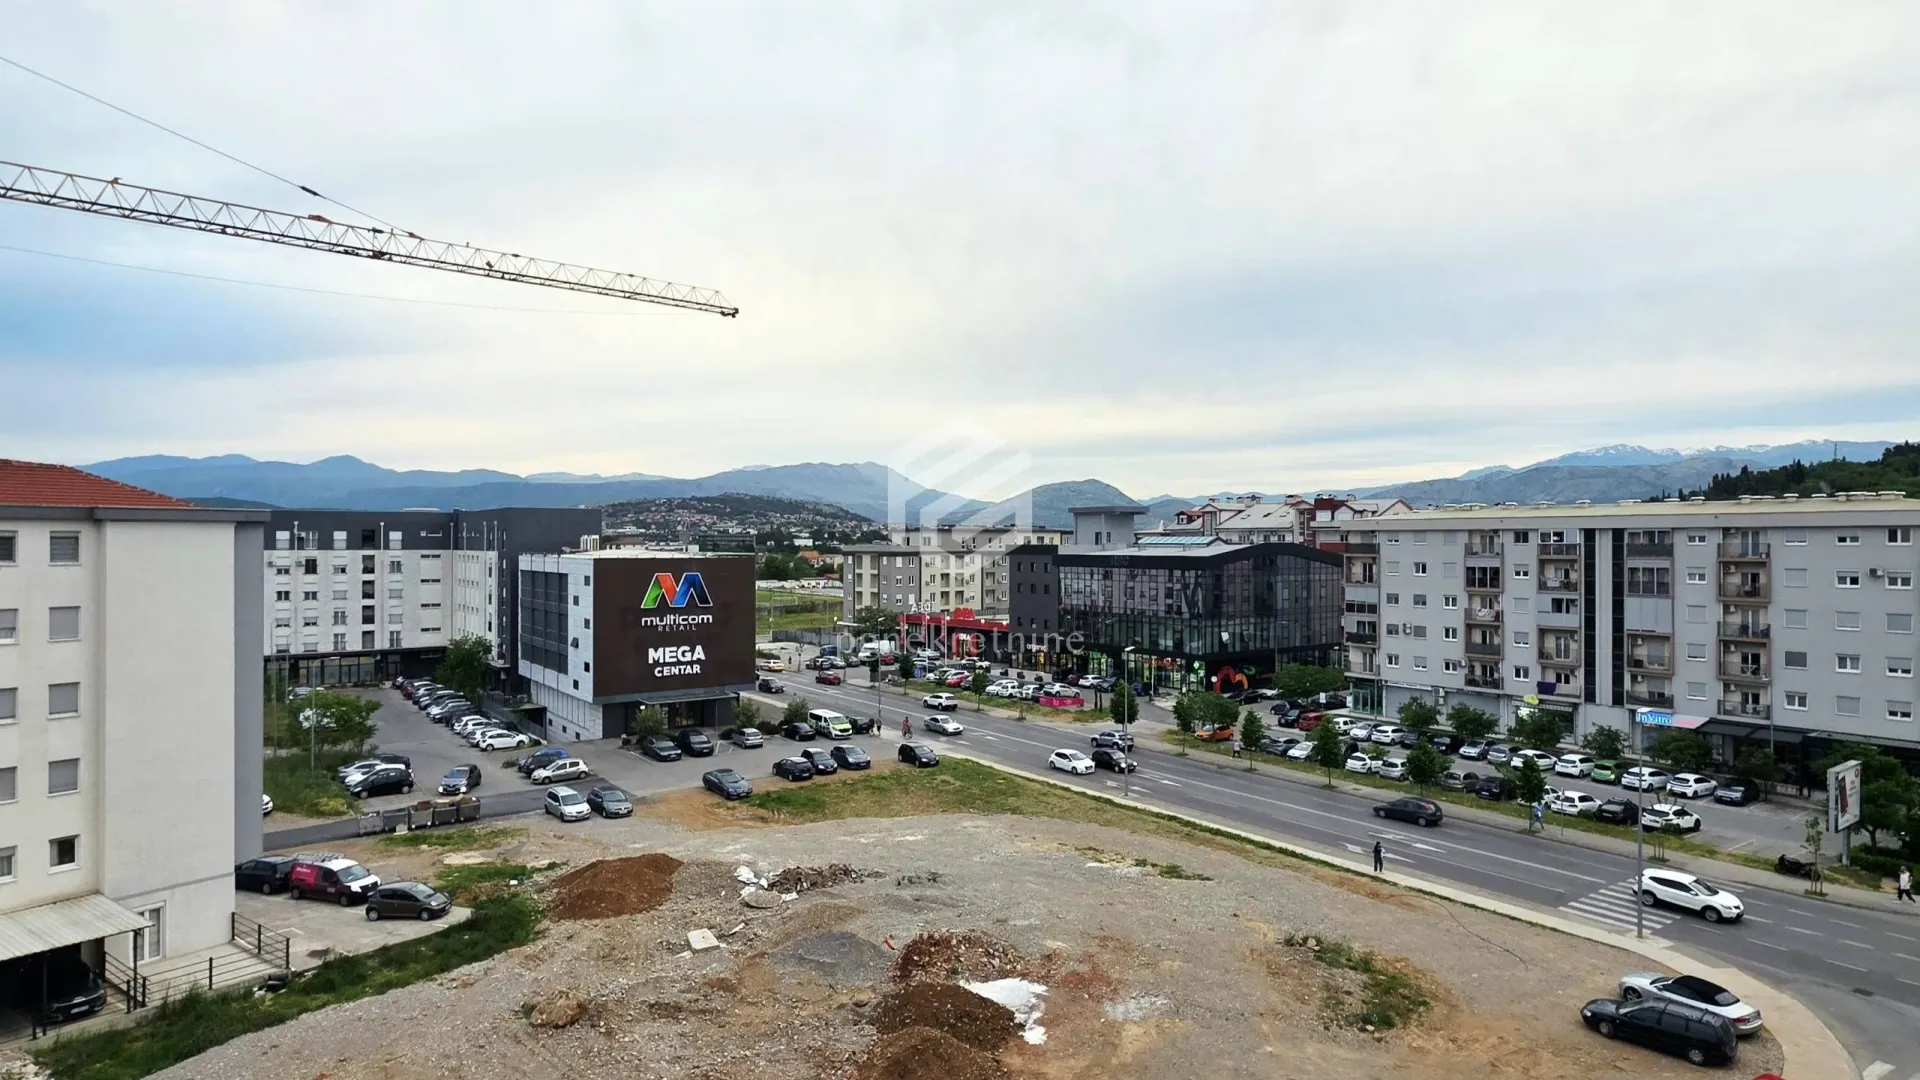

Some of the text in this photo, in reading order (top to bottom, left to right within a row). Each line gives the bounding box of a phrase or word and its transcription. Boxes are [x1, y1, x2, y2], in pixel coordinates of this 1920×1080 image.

[641, 614, 713, 626] multicom
[647, 645, 706, 664] MEGA
[654, 664, 701, 677] CENTAR
